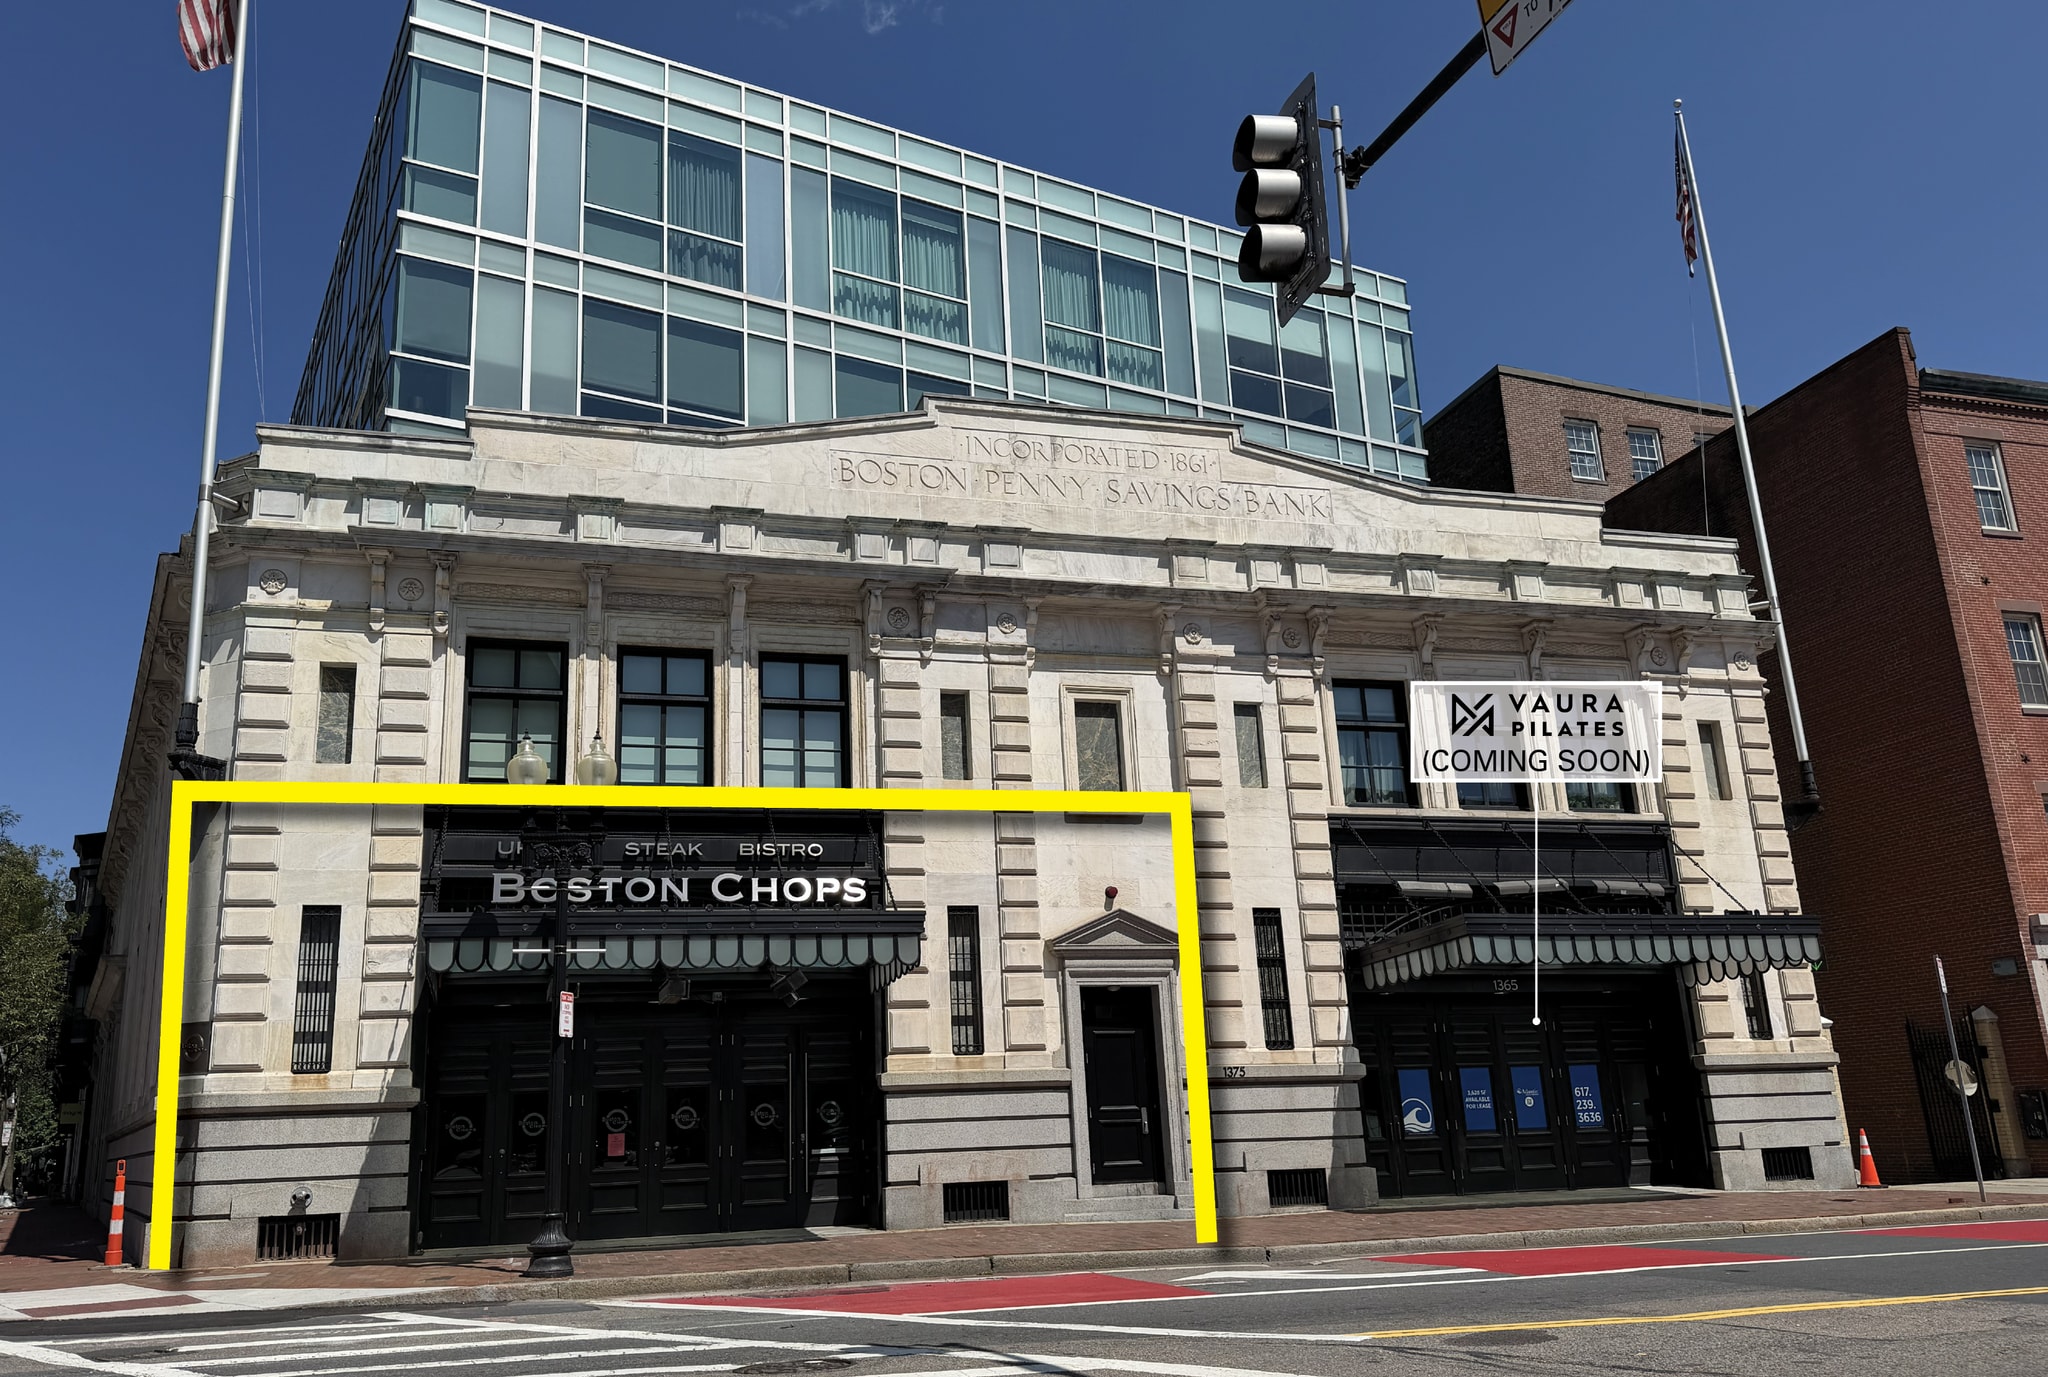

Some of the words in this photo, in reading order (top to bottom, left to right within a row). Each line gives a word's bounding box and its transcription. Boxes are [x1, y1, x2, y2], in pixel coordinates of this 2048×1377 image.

[966, 436, 1159, 470] INCORPORATED
[1170, 452, 1208, 474] 1861
[839, 457, 967, 491] BOSTON
[985, 470, 1090, 501] PENNY
[1106, 479, 1231, 511] SAVINGS
[1244, 490, 1329, 518] BANK
[624, 841, 703, 857] STEAK
[739, 842, 824, 857] BISTRO
[711, 873, 867, 903] CHOPS
[1493, 979, 1519, 991] 1365
[1223, 1066, 1246, 1078] 1375
[1574, 1086, 1592, 1097] 617.
[1576, 1099, 1597, 1110] 239.
[1577, 1112, 1602, 1123] 3636
